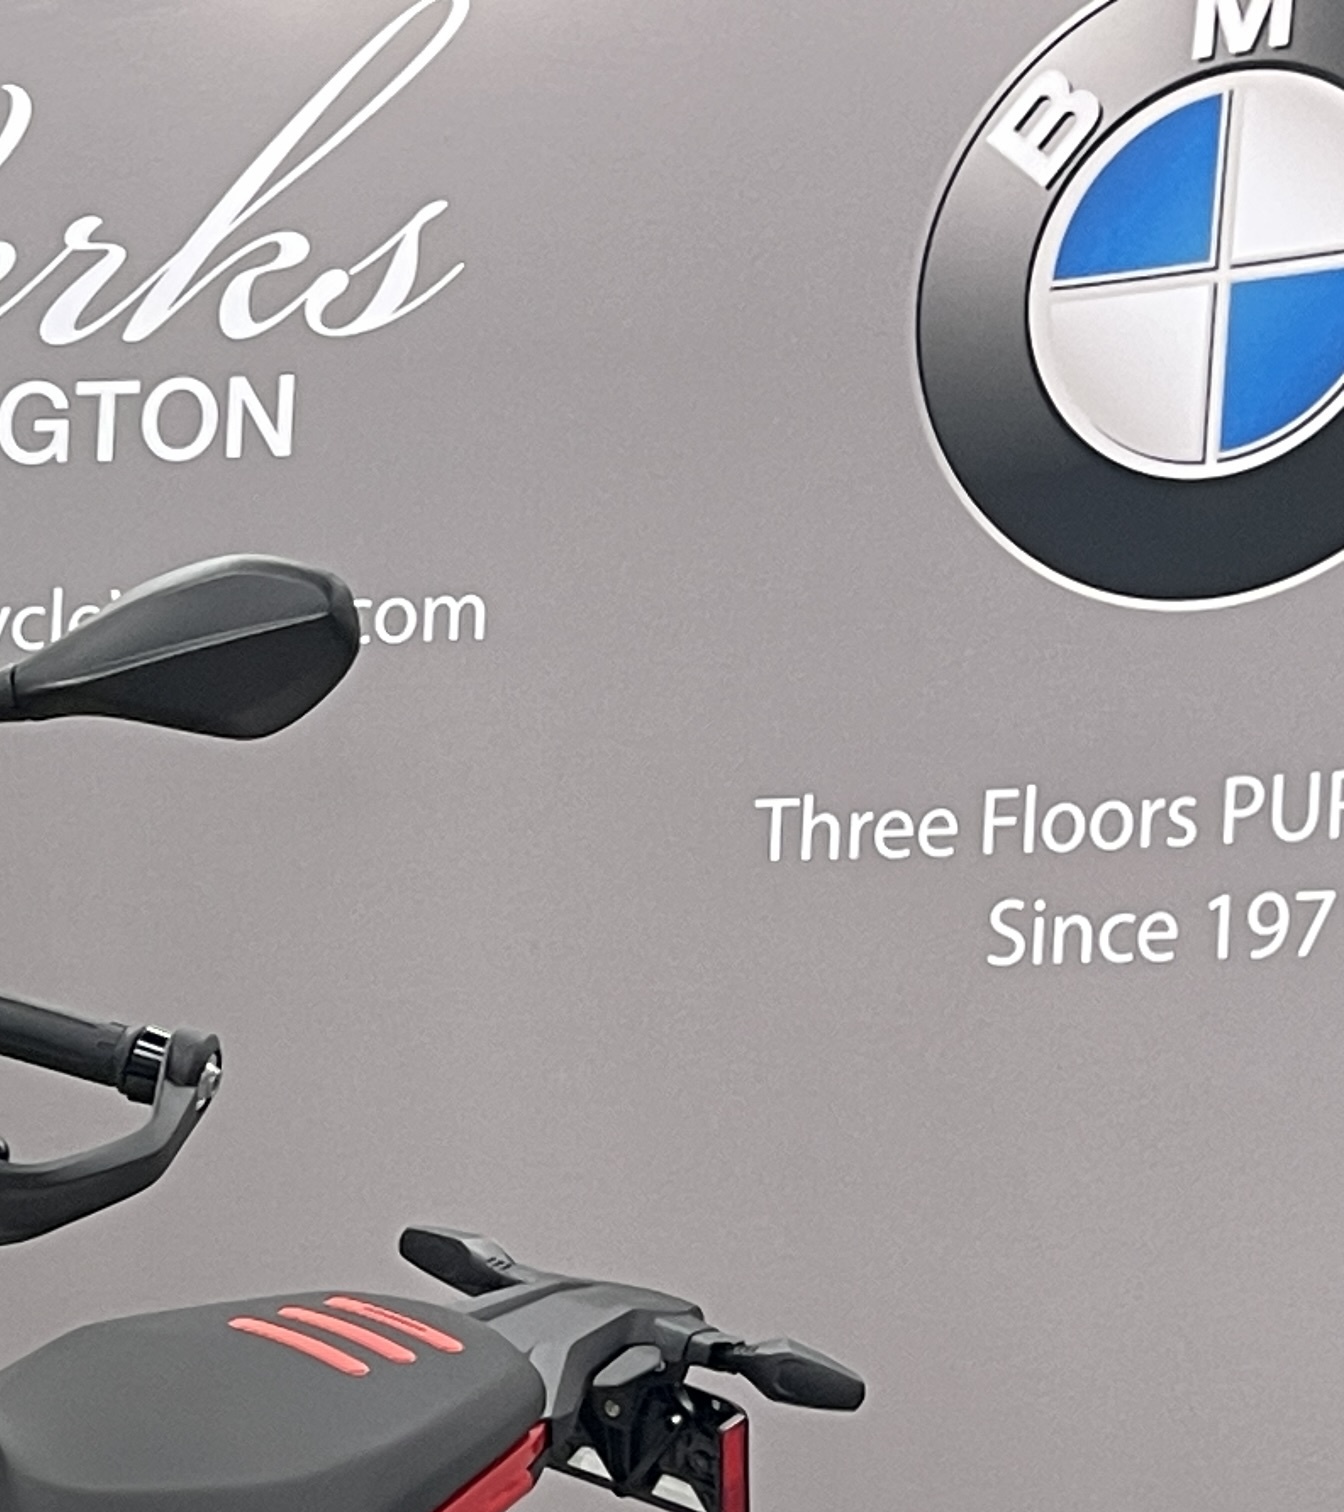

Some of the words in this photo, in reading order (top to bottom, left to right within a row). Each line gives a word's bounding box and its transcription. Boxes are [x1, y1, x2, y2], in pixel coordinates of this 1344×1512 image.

[753, 792, 959, 863] Three
[981, 783, 1198, 856] Floors
[986, 898, 1180, 967] Since
